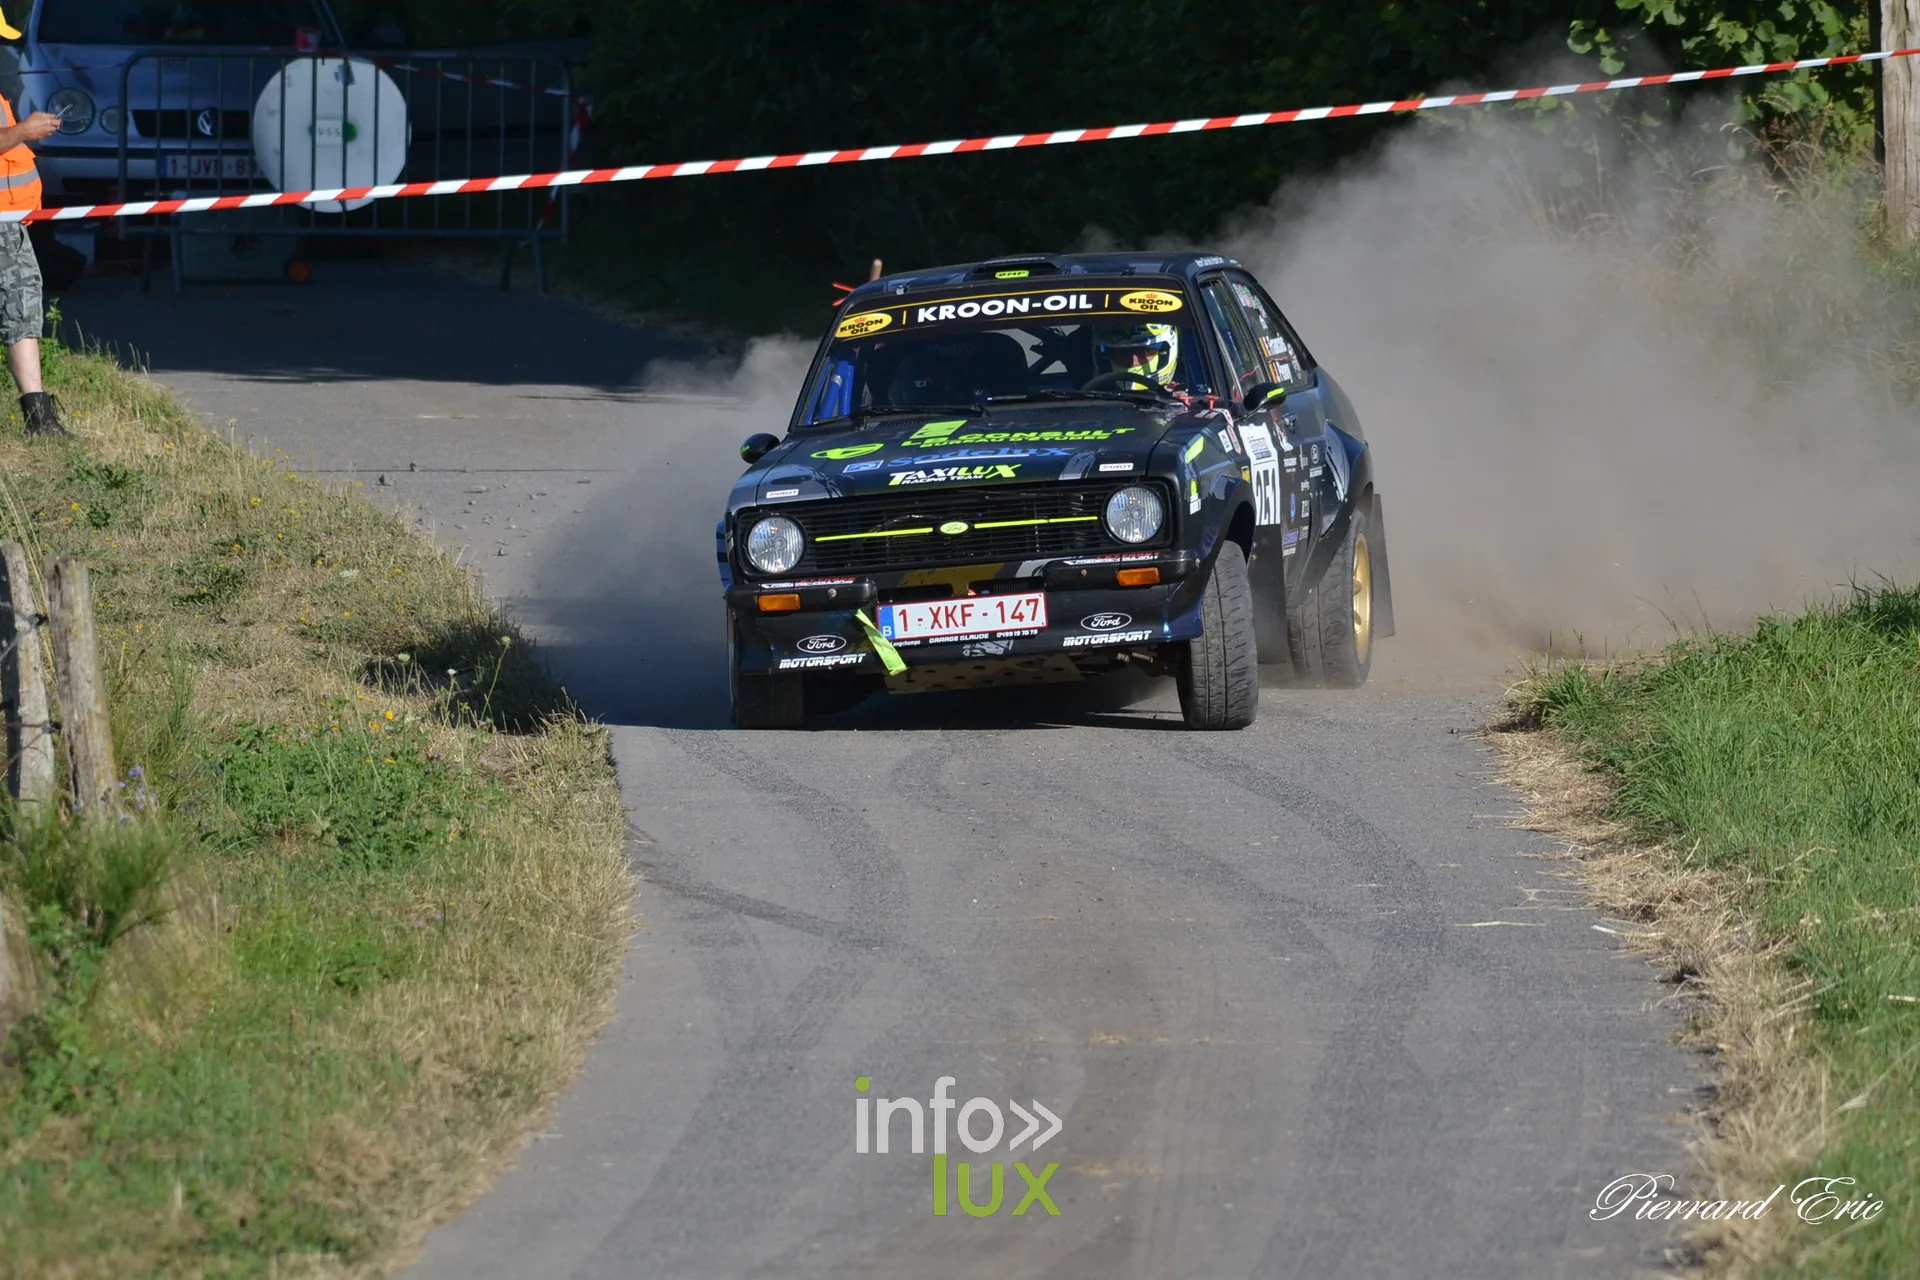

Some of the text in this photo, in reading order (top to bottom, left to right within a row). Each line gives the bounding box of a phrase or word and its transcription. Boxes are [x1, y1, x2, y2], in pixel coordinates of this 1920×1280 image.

[1129, 297, 1173, 306] KROON
[1140, 303, 1160, 311] OIL
[917, 294, 1092, 323] KROON-OIL
[840, 318, 883, 332] KROON
[850, 326, 870, 335] OIL
[958, 427, 1136, 443] CONSULT
[889, 464, 1021, 486] TAXILUX
[901, 474, 984, 485] RACING TEAM
[1256, 468, 1277, 526] 251
[1091, 615, 1121, 628] Ford
[882, 625, 893, 637] B
[807, 638, 836, 650] Ford
[929, 636, 959, 644] GARAGE
[1063, 630, 1152, 647] MOTORSPORT
[779, 653, 866, 669] MOTORSPORT
